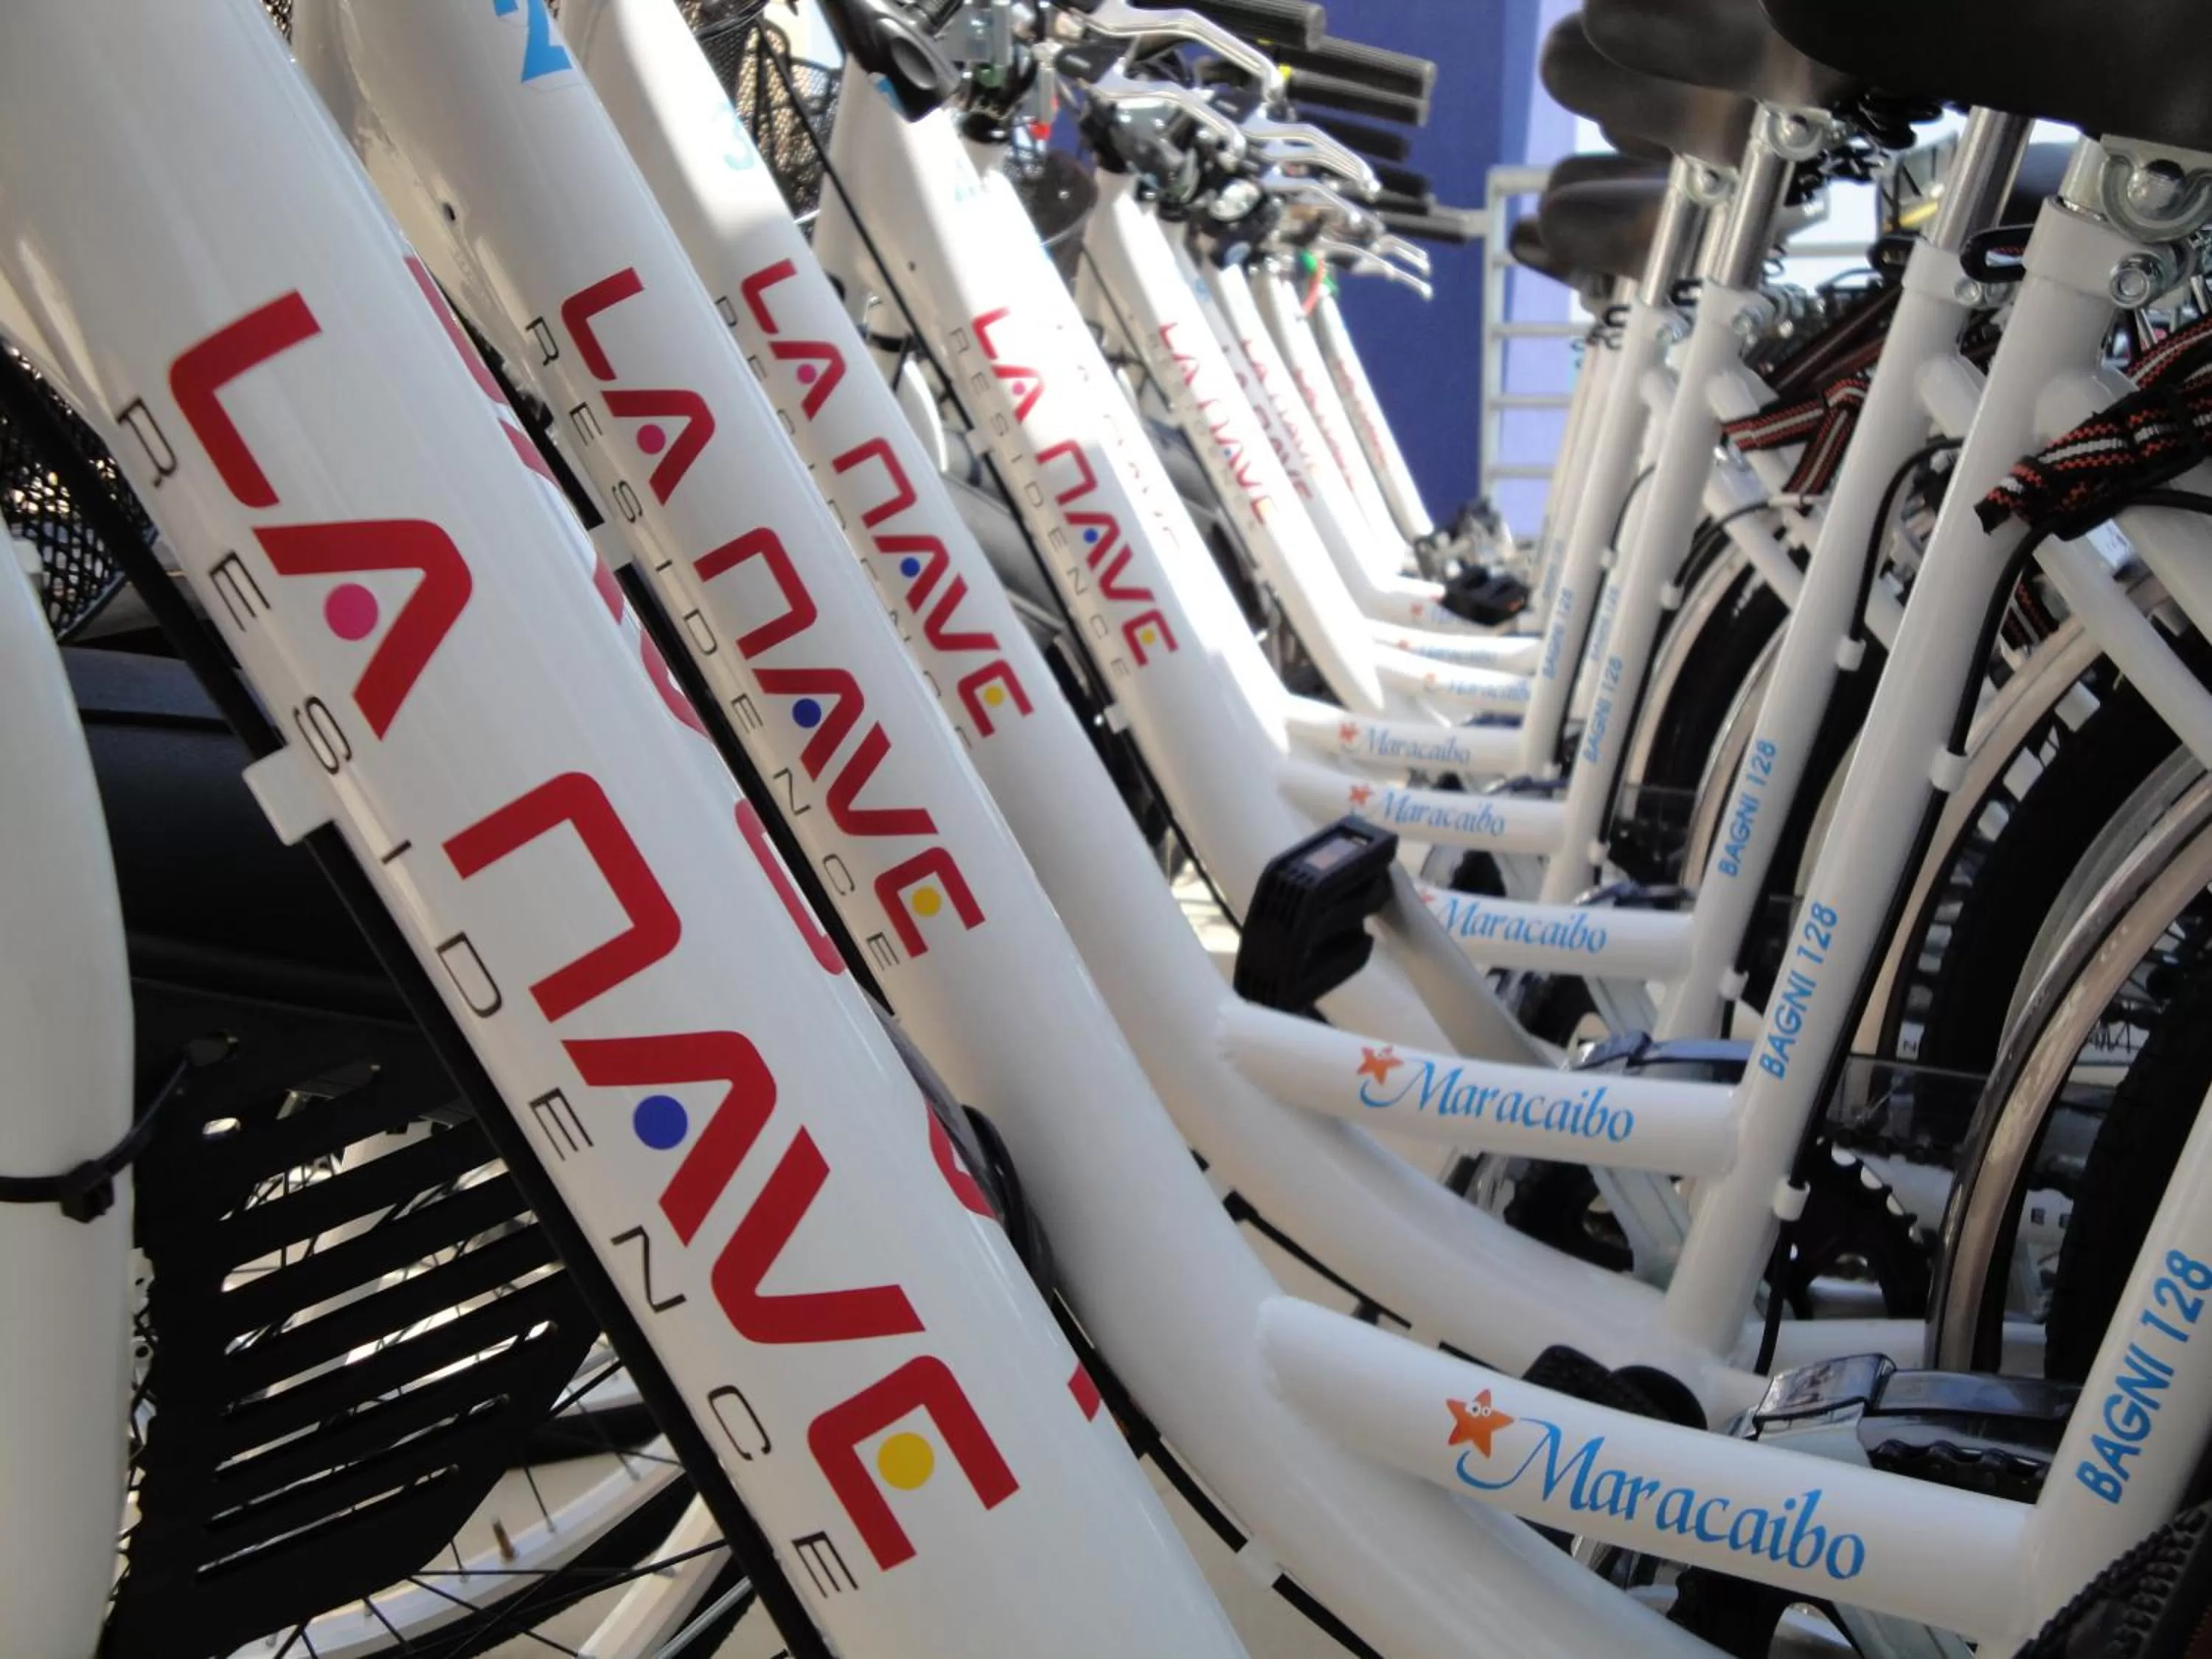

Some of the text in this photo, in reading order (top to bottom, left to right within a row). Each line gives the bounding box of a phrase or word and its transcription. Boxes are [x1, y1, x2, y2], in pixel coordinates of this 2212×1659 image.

[560, 266, 716, 507] LA
[693, 526, 986, 959] NAVE
[741, 258, 846, 422] LA
[832, 437, 1034, 738] NAVE
[950, 327, 1131, 680] RESIDENCE
[972, 306, 1045, 423] LA
[1037, 439, 1178, 667] NAVE
[524, 316, 900, 970] RESIDENCE
[1602, 655, 1622, 692] 128
[168, 288, 473, 742] LA
[442, 771, 1020, 1572] NAVE
[1381, 787, 1506, 837] Maracaibo
[1432, 896, 1607, 954] Maracaibo
[1718, 740, 1776, 878] BAGNI 128
[117, 397, 858, 1599] RESIDENCE
[1359, 1060, 1635, 1143] Maracaibo
[1759, 902, 1838, 1080] BAGNI 128
[1457, 1417, 1865, 1581] Maracaibo
[2076, 1250, 2212, 1504] BAGNI 128
